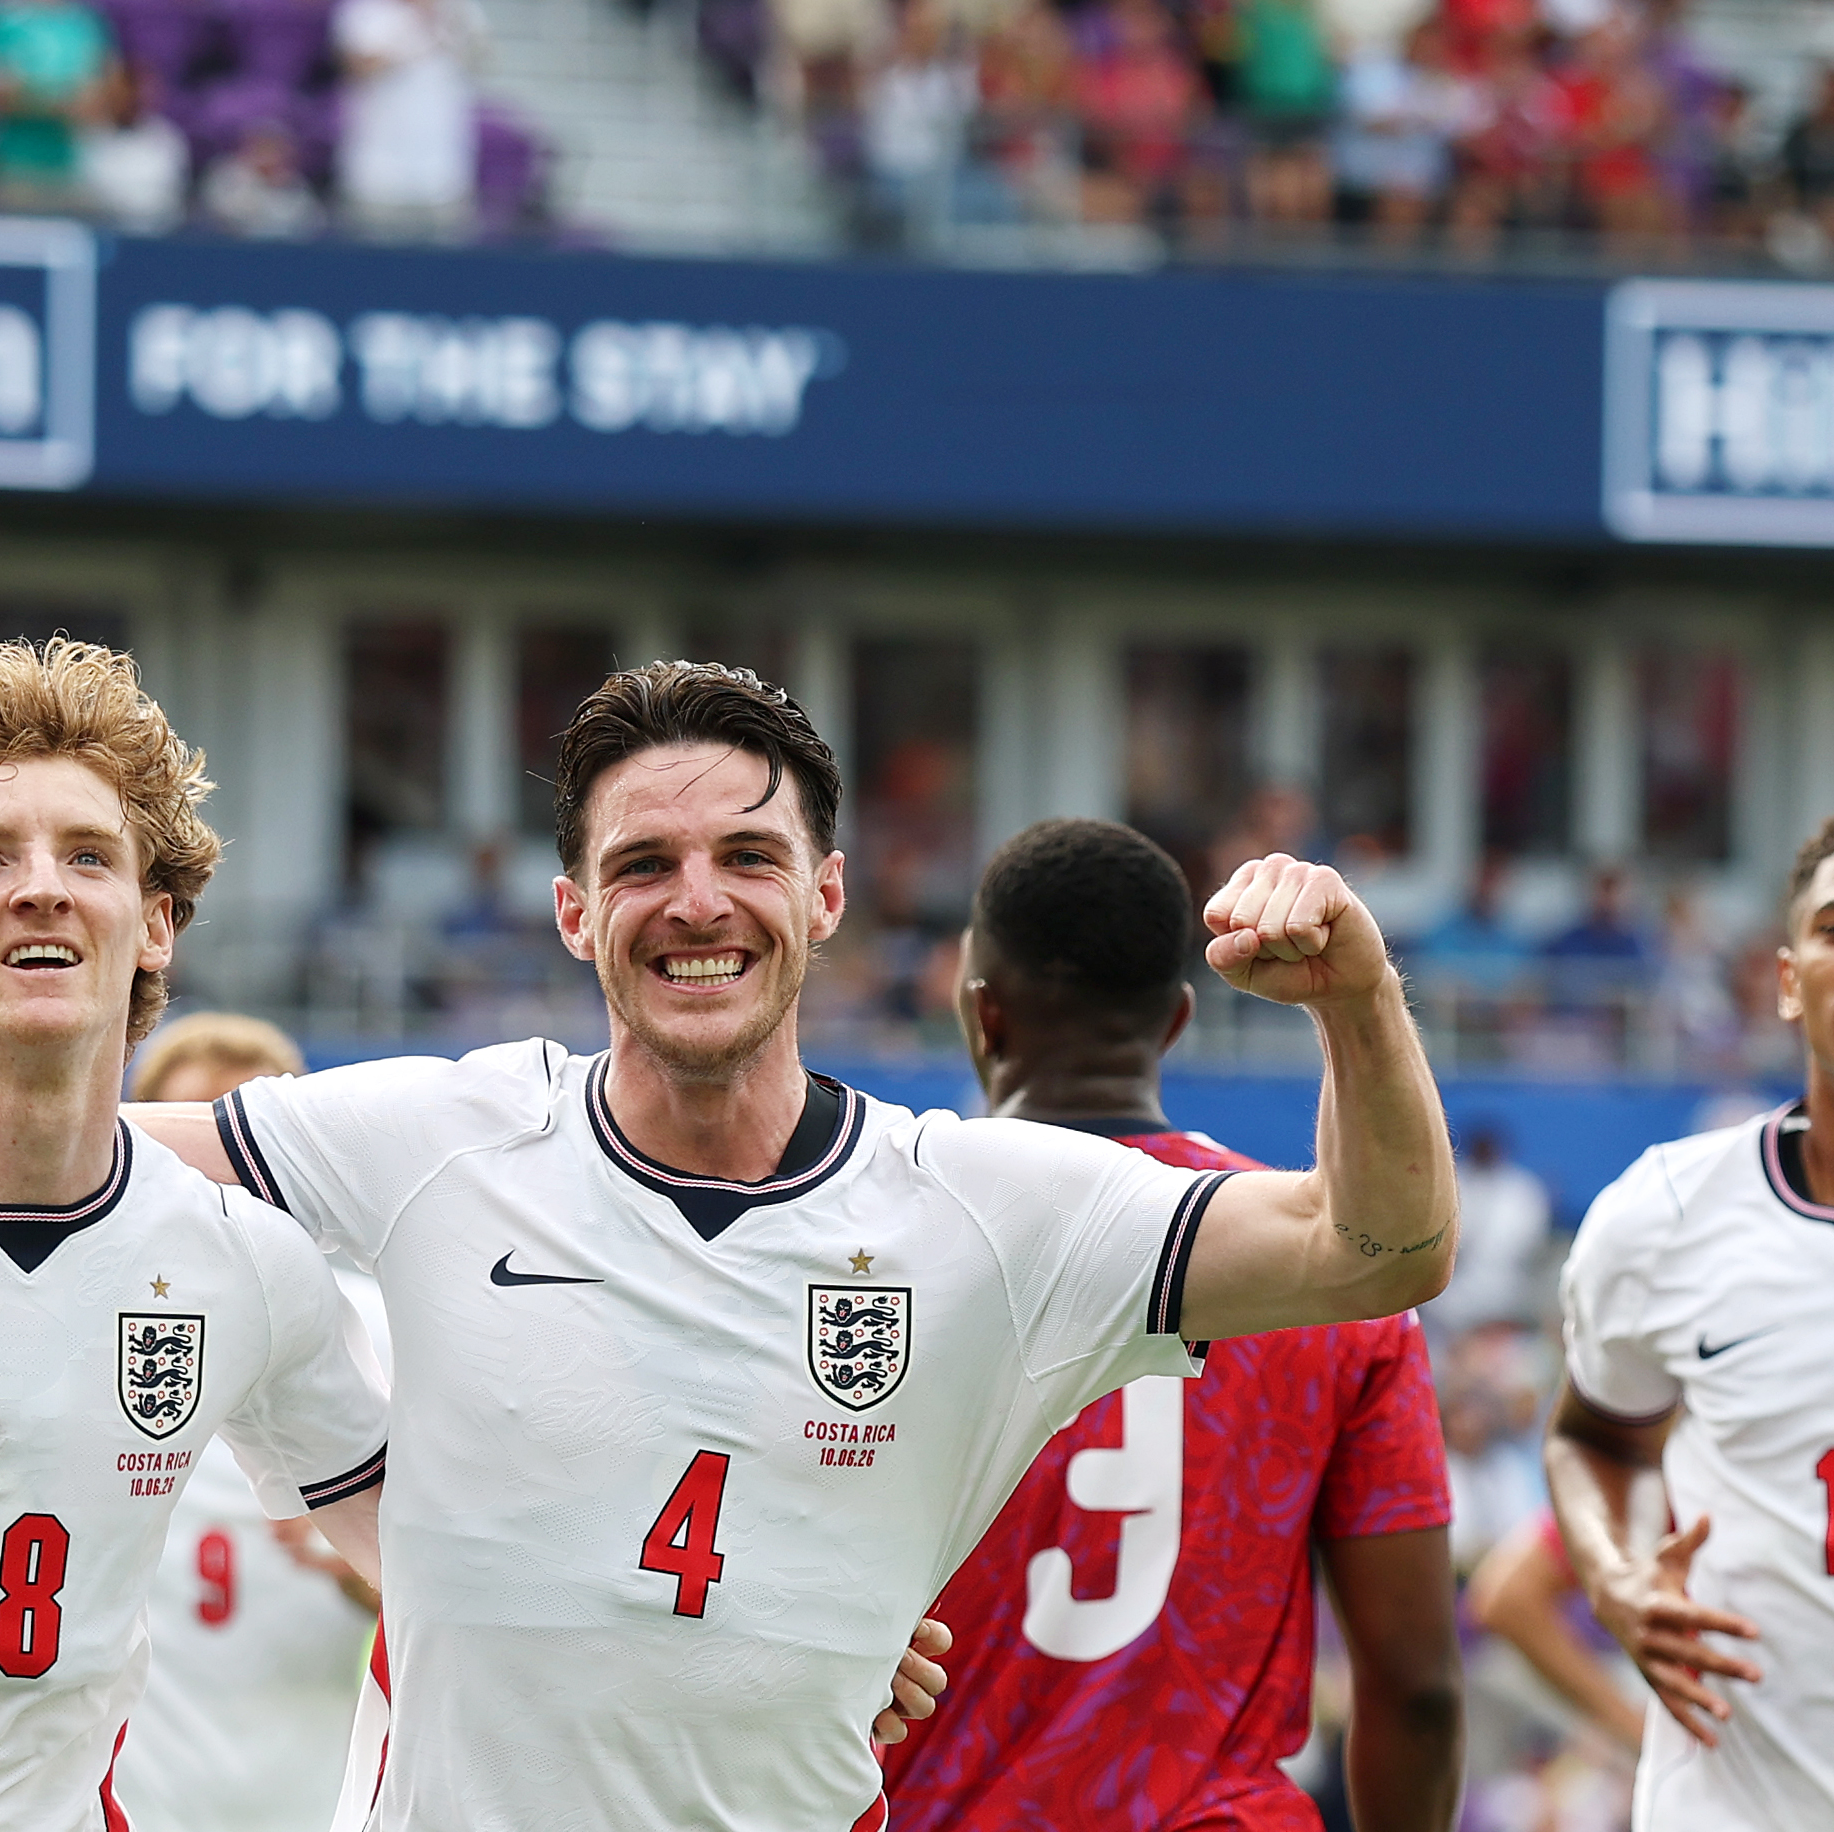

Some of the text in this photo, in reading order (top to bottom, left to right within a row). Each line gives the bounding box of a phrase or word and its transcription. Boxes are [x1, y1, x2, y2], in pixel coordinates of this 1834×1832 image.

[127, 303, 344, 420] FOR
[352, 311, 564, 430] THE
[804, 1420, 896, 1443] COSTA RICA
[117, 1450, 192, 1471] COSTA RICA
[819, 1447, 875, 1467] 10.06.26
[130, 1476, 175, 1496] 10.06.26
[639, 1449, 731, 1618] 4
[195, 1528, 235, 1630] 9
